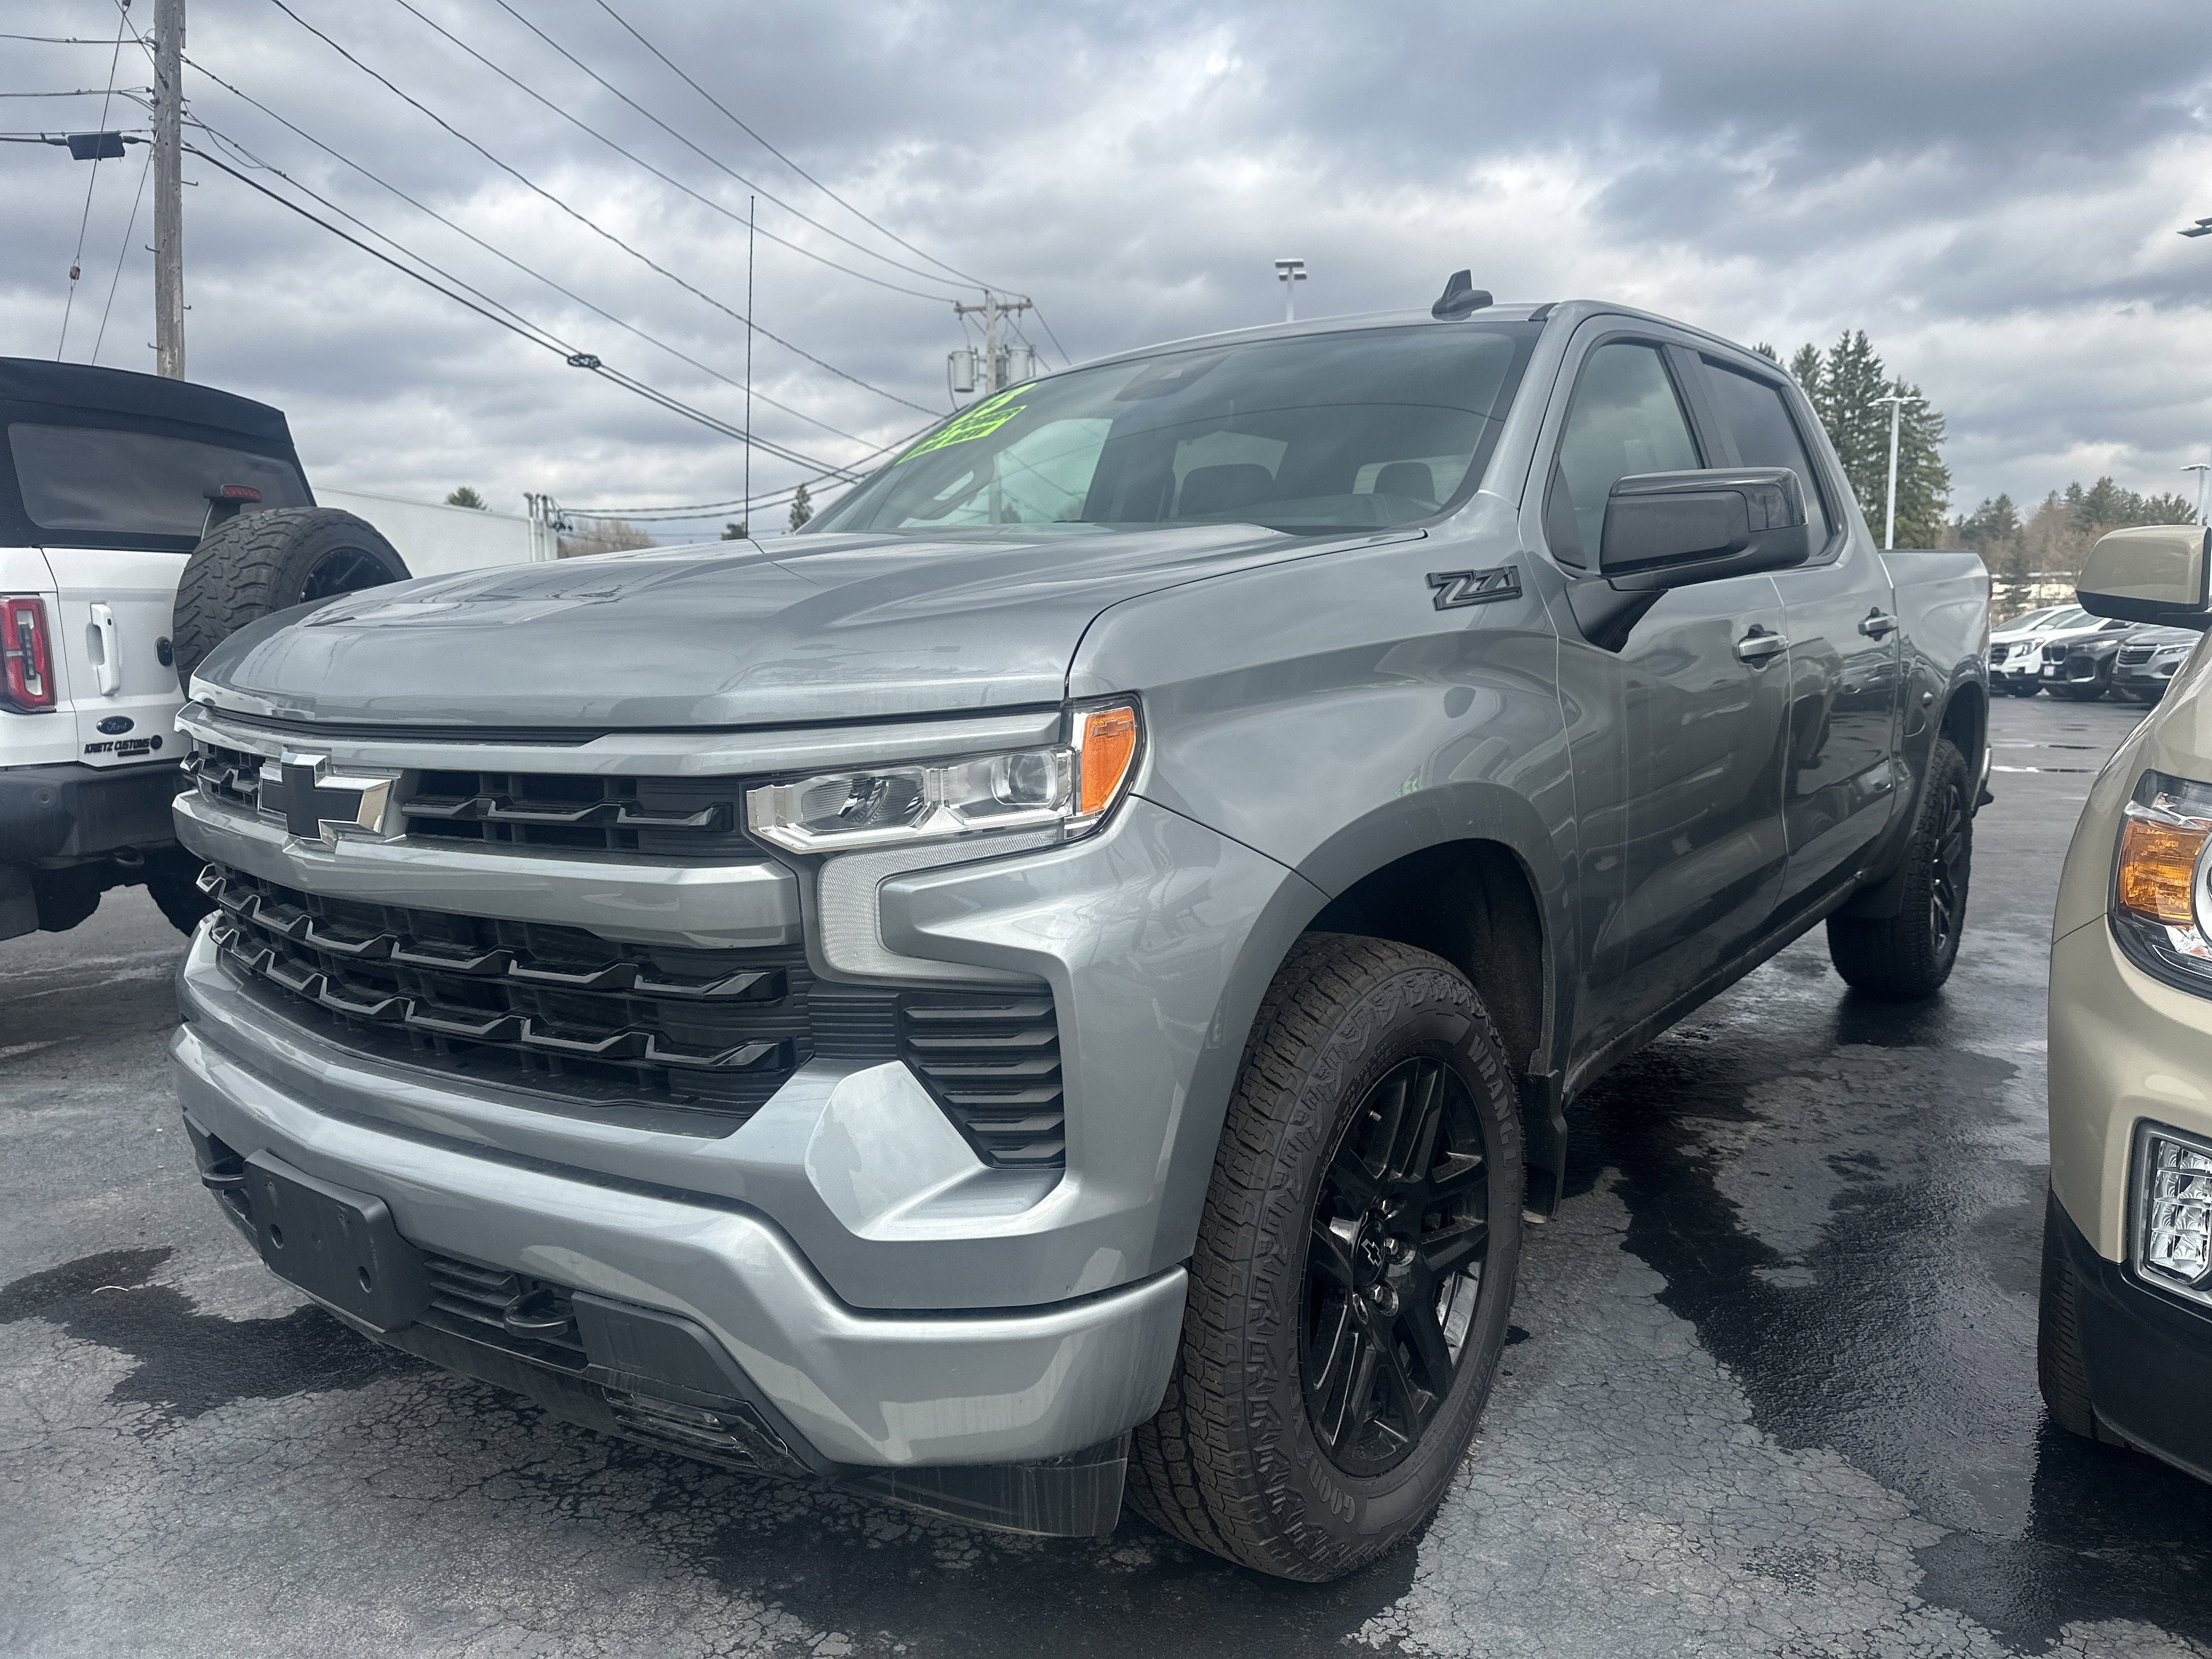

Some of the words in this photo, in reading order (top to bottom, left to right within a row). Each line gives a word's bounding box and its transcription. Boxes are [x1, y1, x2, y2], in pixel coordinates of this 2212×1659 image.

[1425, 565, 1523, 611] Z71
[107, 720, 128, 731] Ford
[1467, 1034, 1518, 1220] WRANGLER
[1442, 1350, 1492, 1464] TERRITORY
